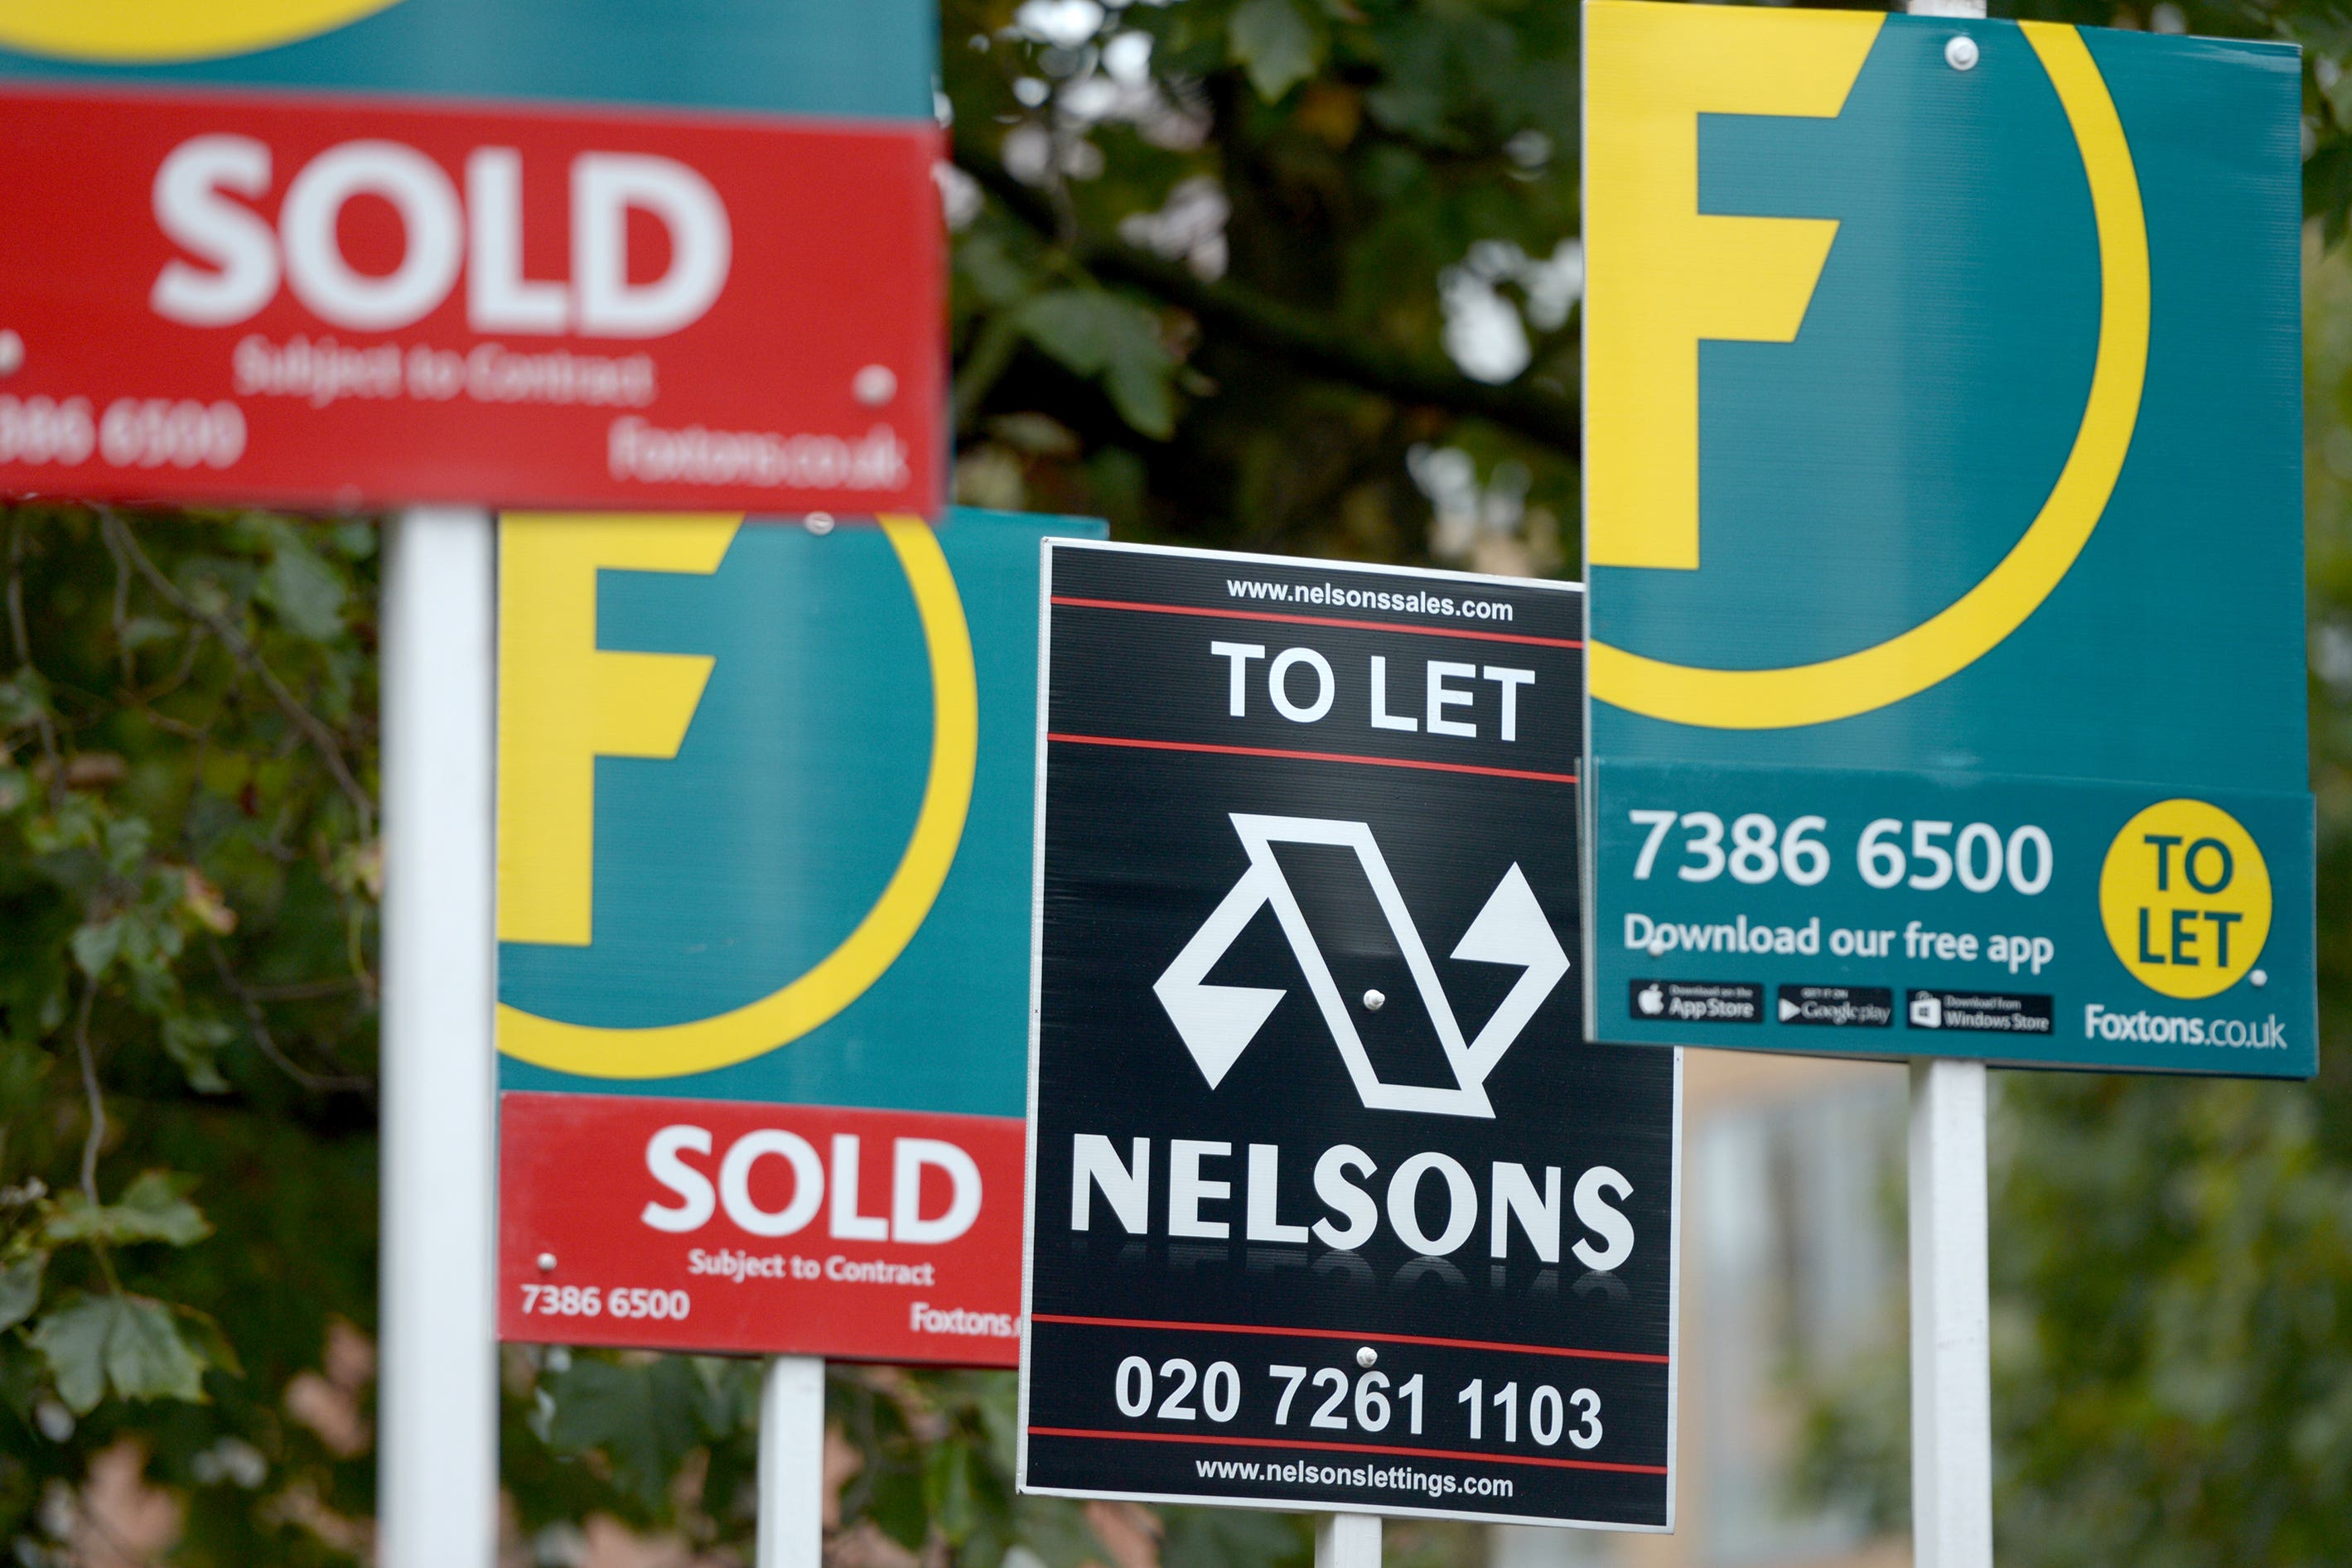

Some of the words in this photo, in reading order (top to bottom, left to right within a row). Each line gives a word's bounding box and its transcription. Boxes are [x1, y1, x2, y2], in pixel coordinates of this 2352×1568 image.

[149, 133, 733, 339] SOLD
[233, 333, 403, 409] Subject
[406, 343, 465, 401] to
[466, 341, 659, 408] Contract
[98, 395, 247, 470] 6500
[607, 414, 910, 491] Foxtons.co.uk
[1227, 579, 1514, 621] www.nelsonssales.com
[1210, 640, 1335, 724] TO
[1370, 655, 1536, 742] LET
[1629, 809, 1831, 885] 7386
[1856, 817, 2054, 895] 6500
[2143, 833, 2234, 895] TO
[1624, 913, 1820, 958] Download
[1828, 928, 1897, 958] our
[1903, 920, 1980, 962] free
[1987, 935, 2055, 976] app
[2137, 906, 2243, 968] LET
[1668, 996, 1707, 1020] App
[1707, 997, 1755, 1019] Store
[1800, 1000, 1858, 1026] Google
[1858, 1004, 1892, 1025] play
[1944, 1010, 2011, 1030] Windows
[2011, 1013, 2050, 1032] Store
[2084, 1003, 2288, 1050] Foxtons.co.uk
[640, 1124, 983, 1245] SOLD
[1070, 1133, 1635, 1271] NELSONS
[687, 1248, 786, 1285] Subject
[789, 1254, 822, 1280] to
[824, 1254, 935, 1287] Contract
[520, 1283, 603, 1318] 7386
[606, 1286, 691, 1320] 6500
[1114, 1355, 1242, 1424] 020
[1268, 1364, 1424, 1435] 7261
[1456, 1377, 1604, 1450] 1103
[1195, 1455, 1514, 1499] www.nelsonslettings.com
